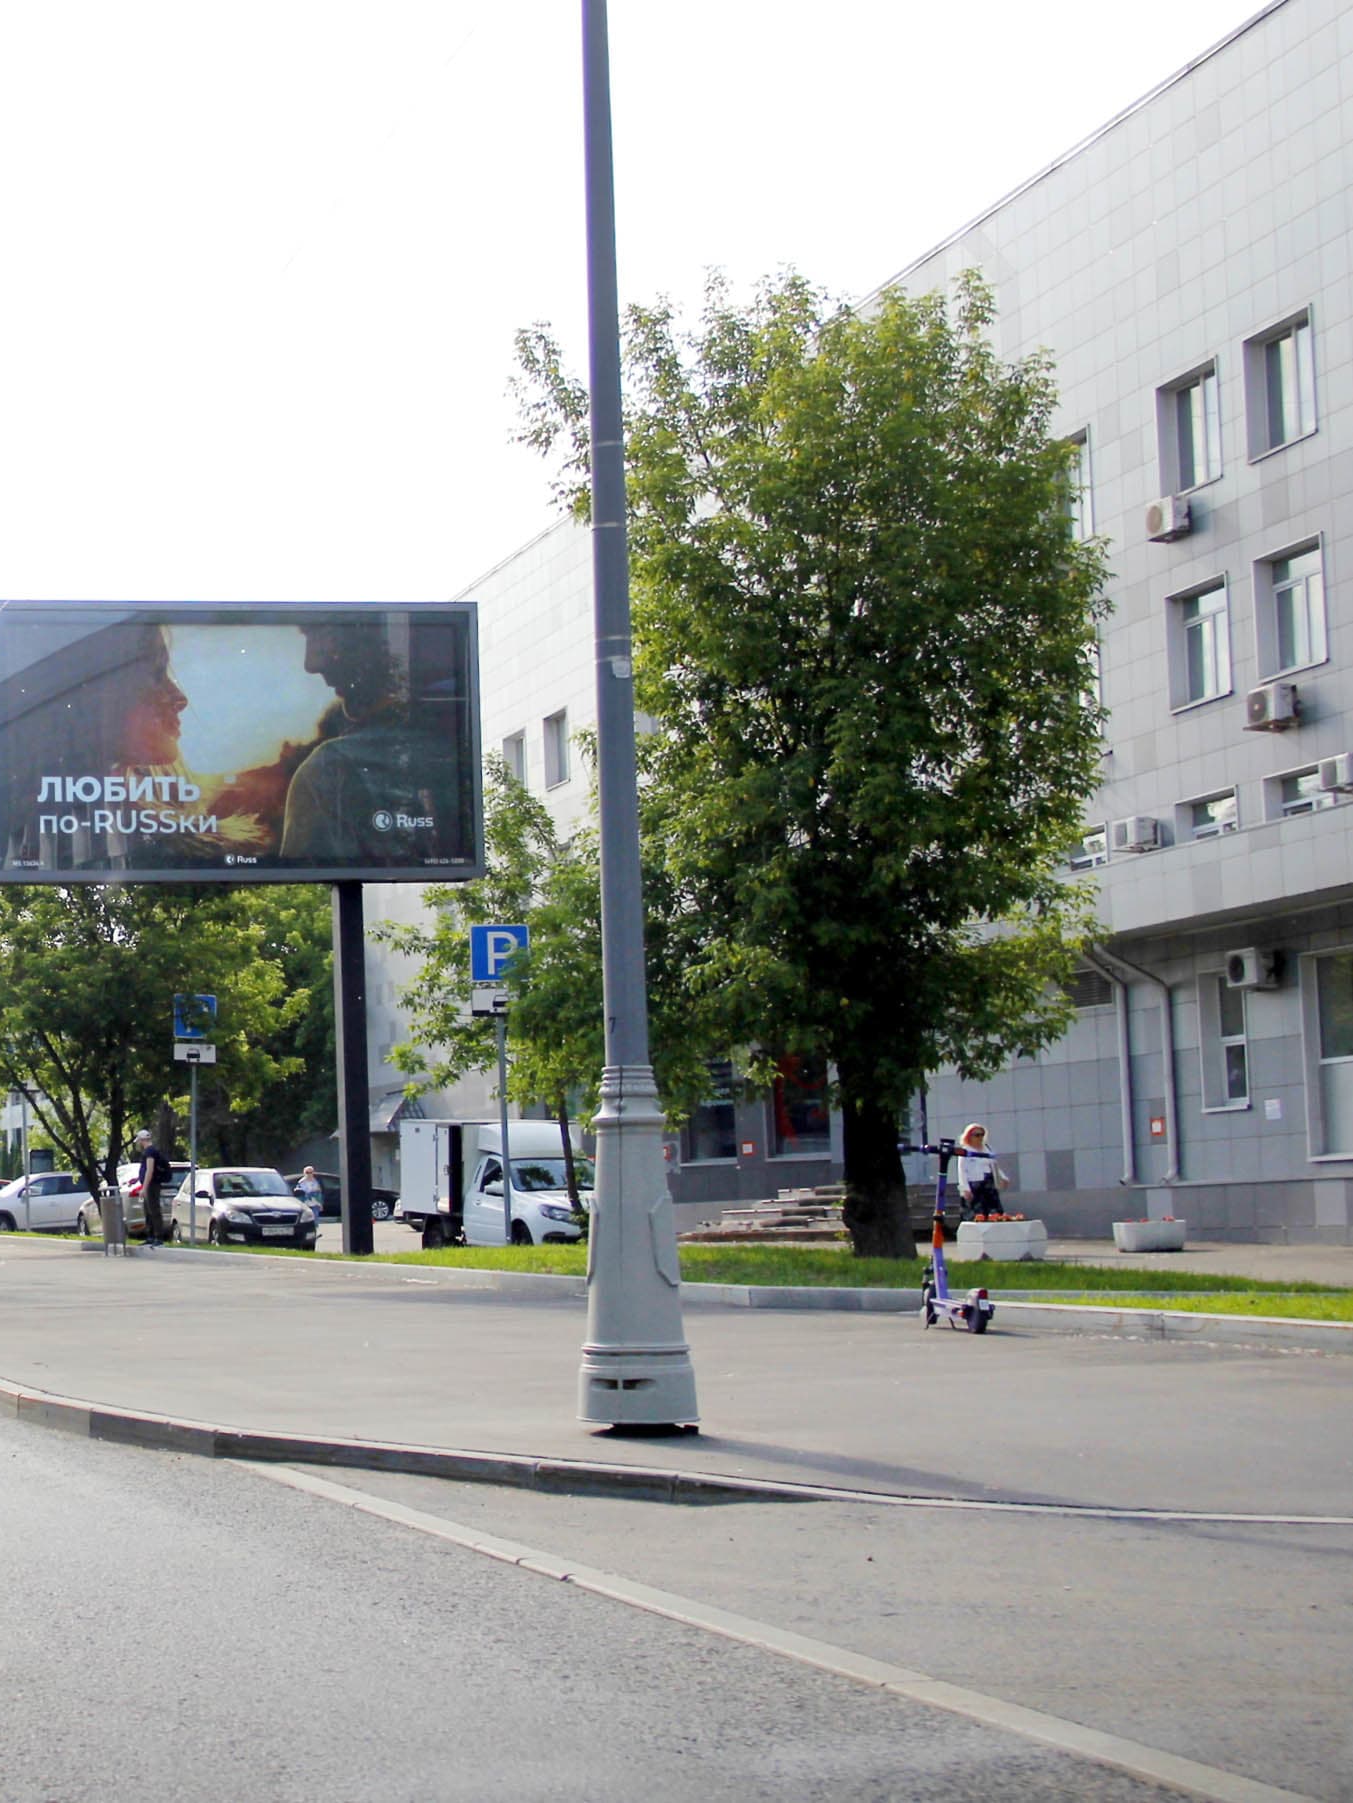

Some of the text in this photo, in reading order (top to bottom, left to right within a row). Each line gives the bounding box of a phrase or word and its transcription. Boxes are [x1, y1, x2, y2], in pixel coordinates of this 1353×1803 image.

[37, 776, 201, 802] ЛЮБИТЬ
[39, 809, 218, 834] по-RUSSки
[396, 814, 435, 828] Russ
[236, 855, 257, 864] Russ
